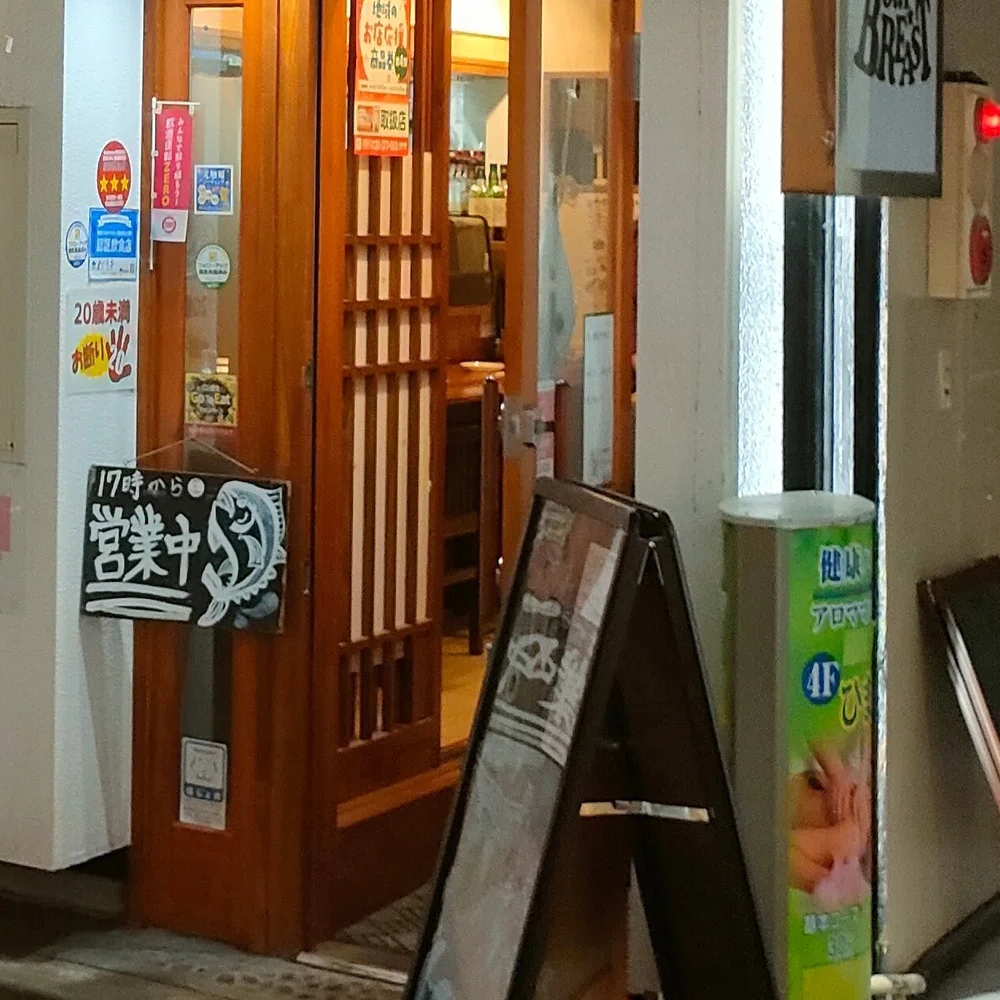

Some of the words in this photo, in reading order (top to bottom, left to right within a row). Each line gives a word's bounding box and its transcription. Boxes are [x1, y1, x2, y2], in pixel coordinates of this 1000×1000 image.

[380, 109, 406, 131] 取扱店
[74, 299, 130, 325] 20歳未満
[71, 336, 105, 374] お断り
[108, 344, 125, 375] 20
[88, 502, 201, 587] 営業中
[806, 660, 840, 700] 4F
